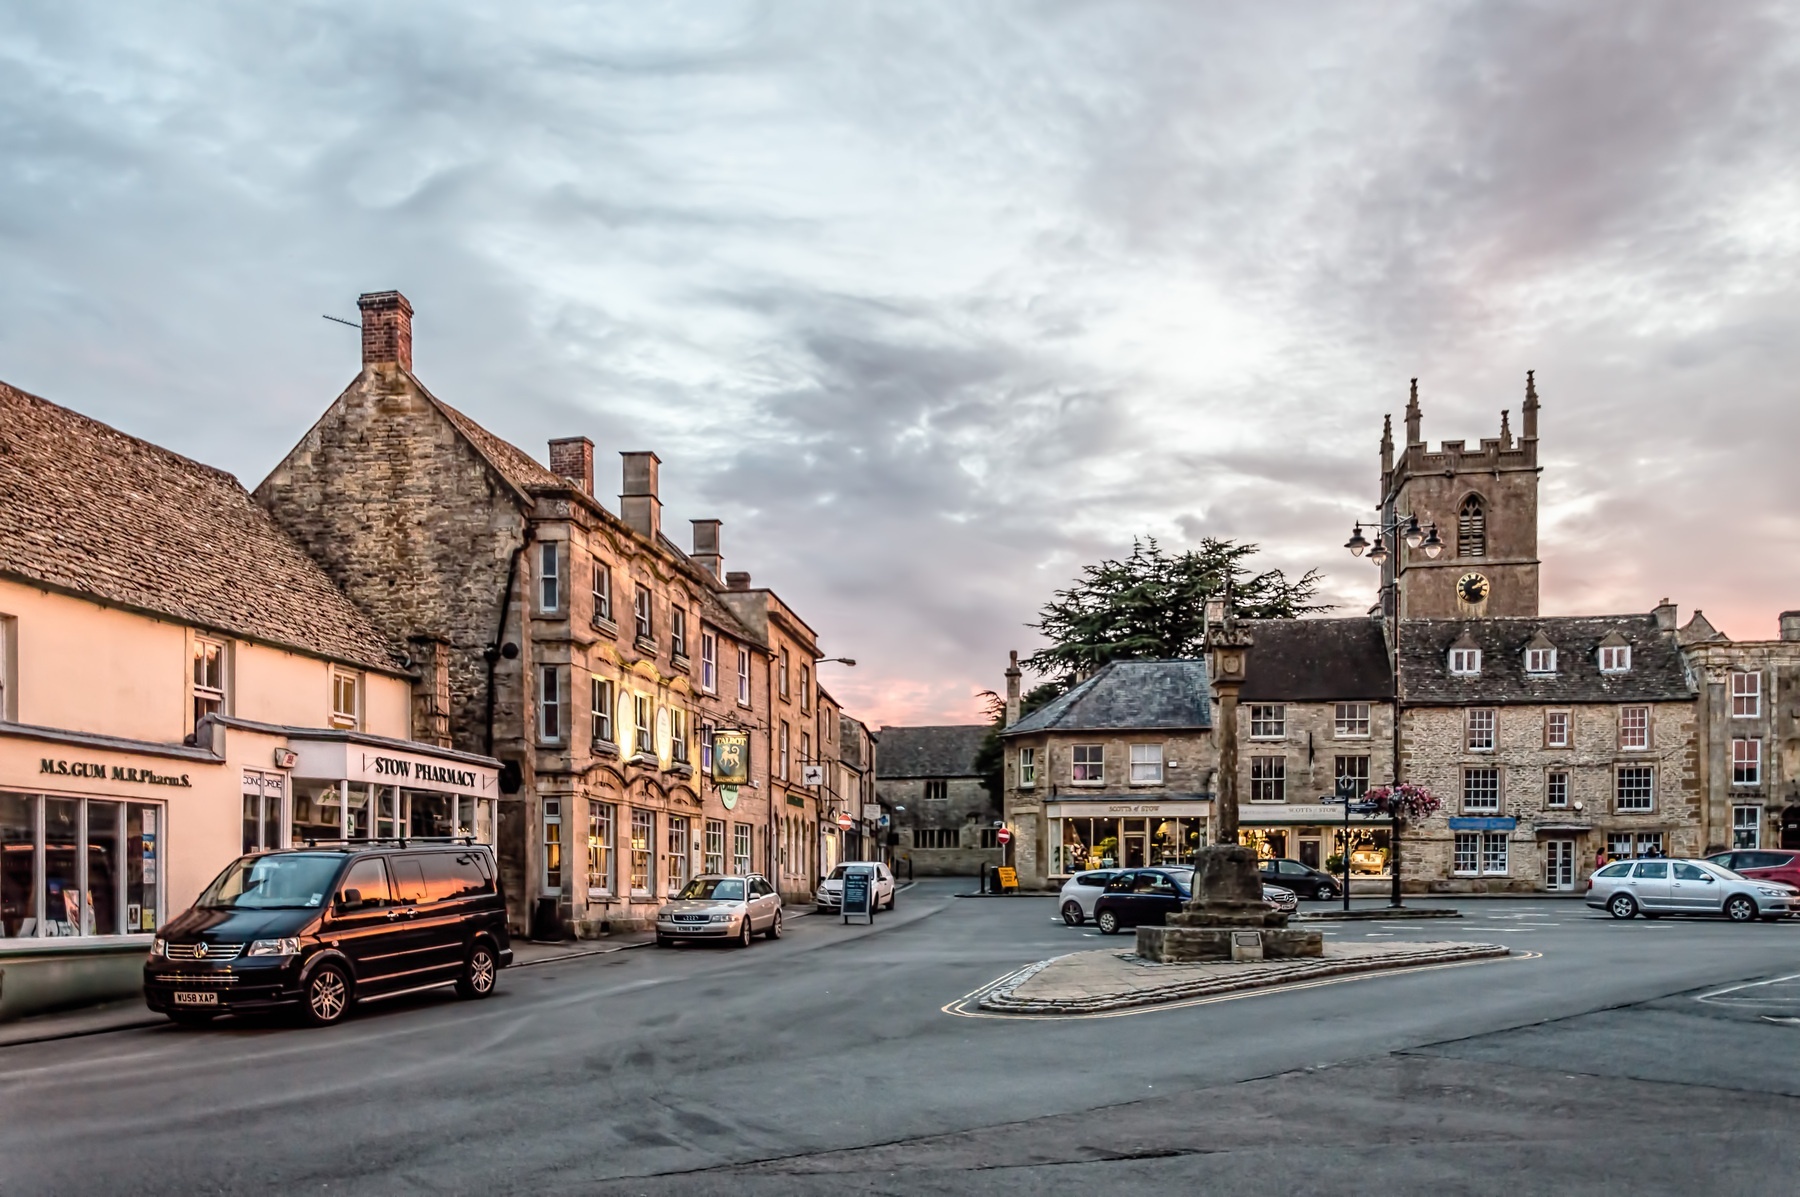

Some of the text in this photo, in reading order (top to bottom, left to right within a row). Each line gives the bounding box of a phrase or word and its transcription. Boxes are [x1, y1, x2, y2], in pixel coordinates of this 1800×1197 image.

[715, 736, 747, 746] TALBOT
[40, 758, 193, 788] M.S.GUM M.R.Pharm.S.
[375, 757, 476, 787] STOW PHARMACY
[199, 993, 215, 1003] XAP
